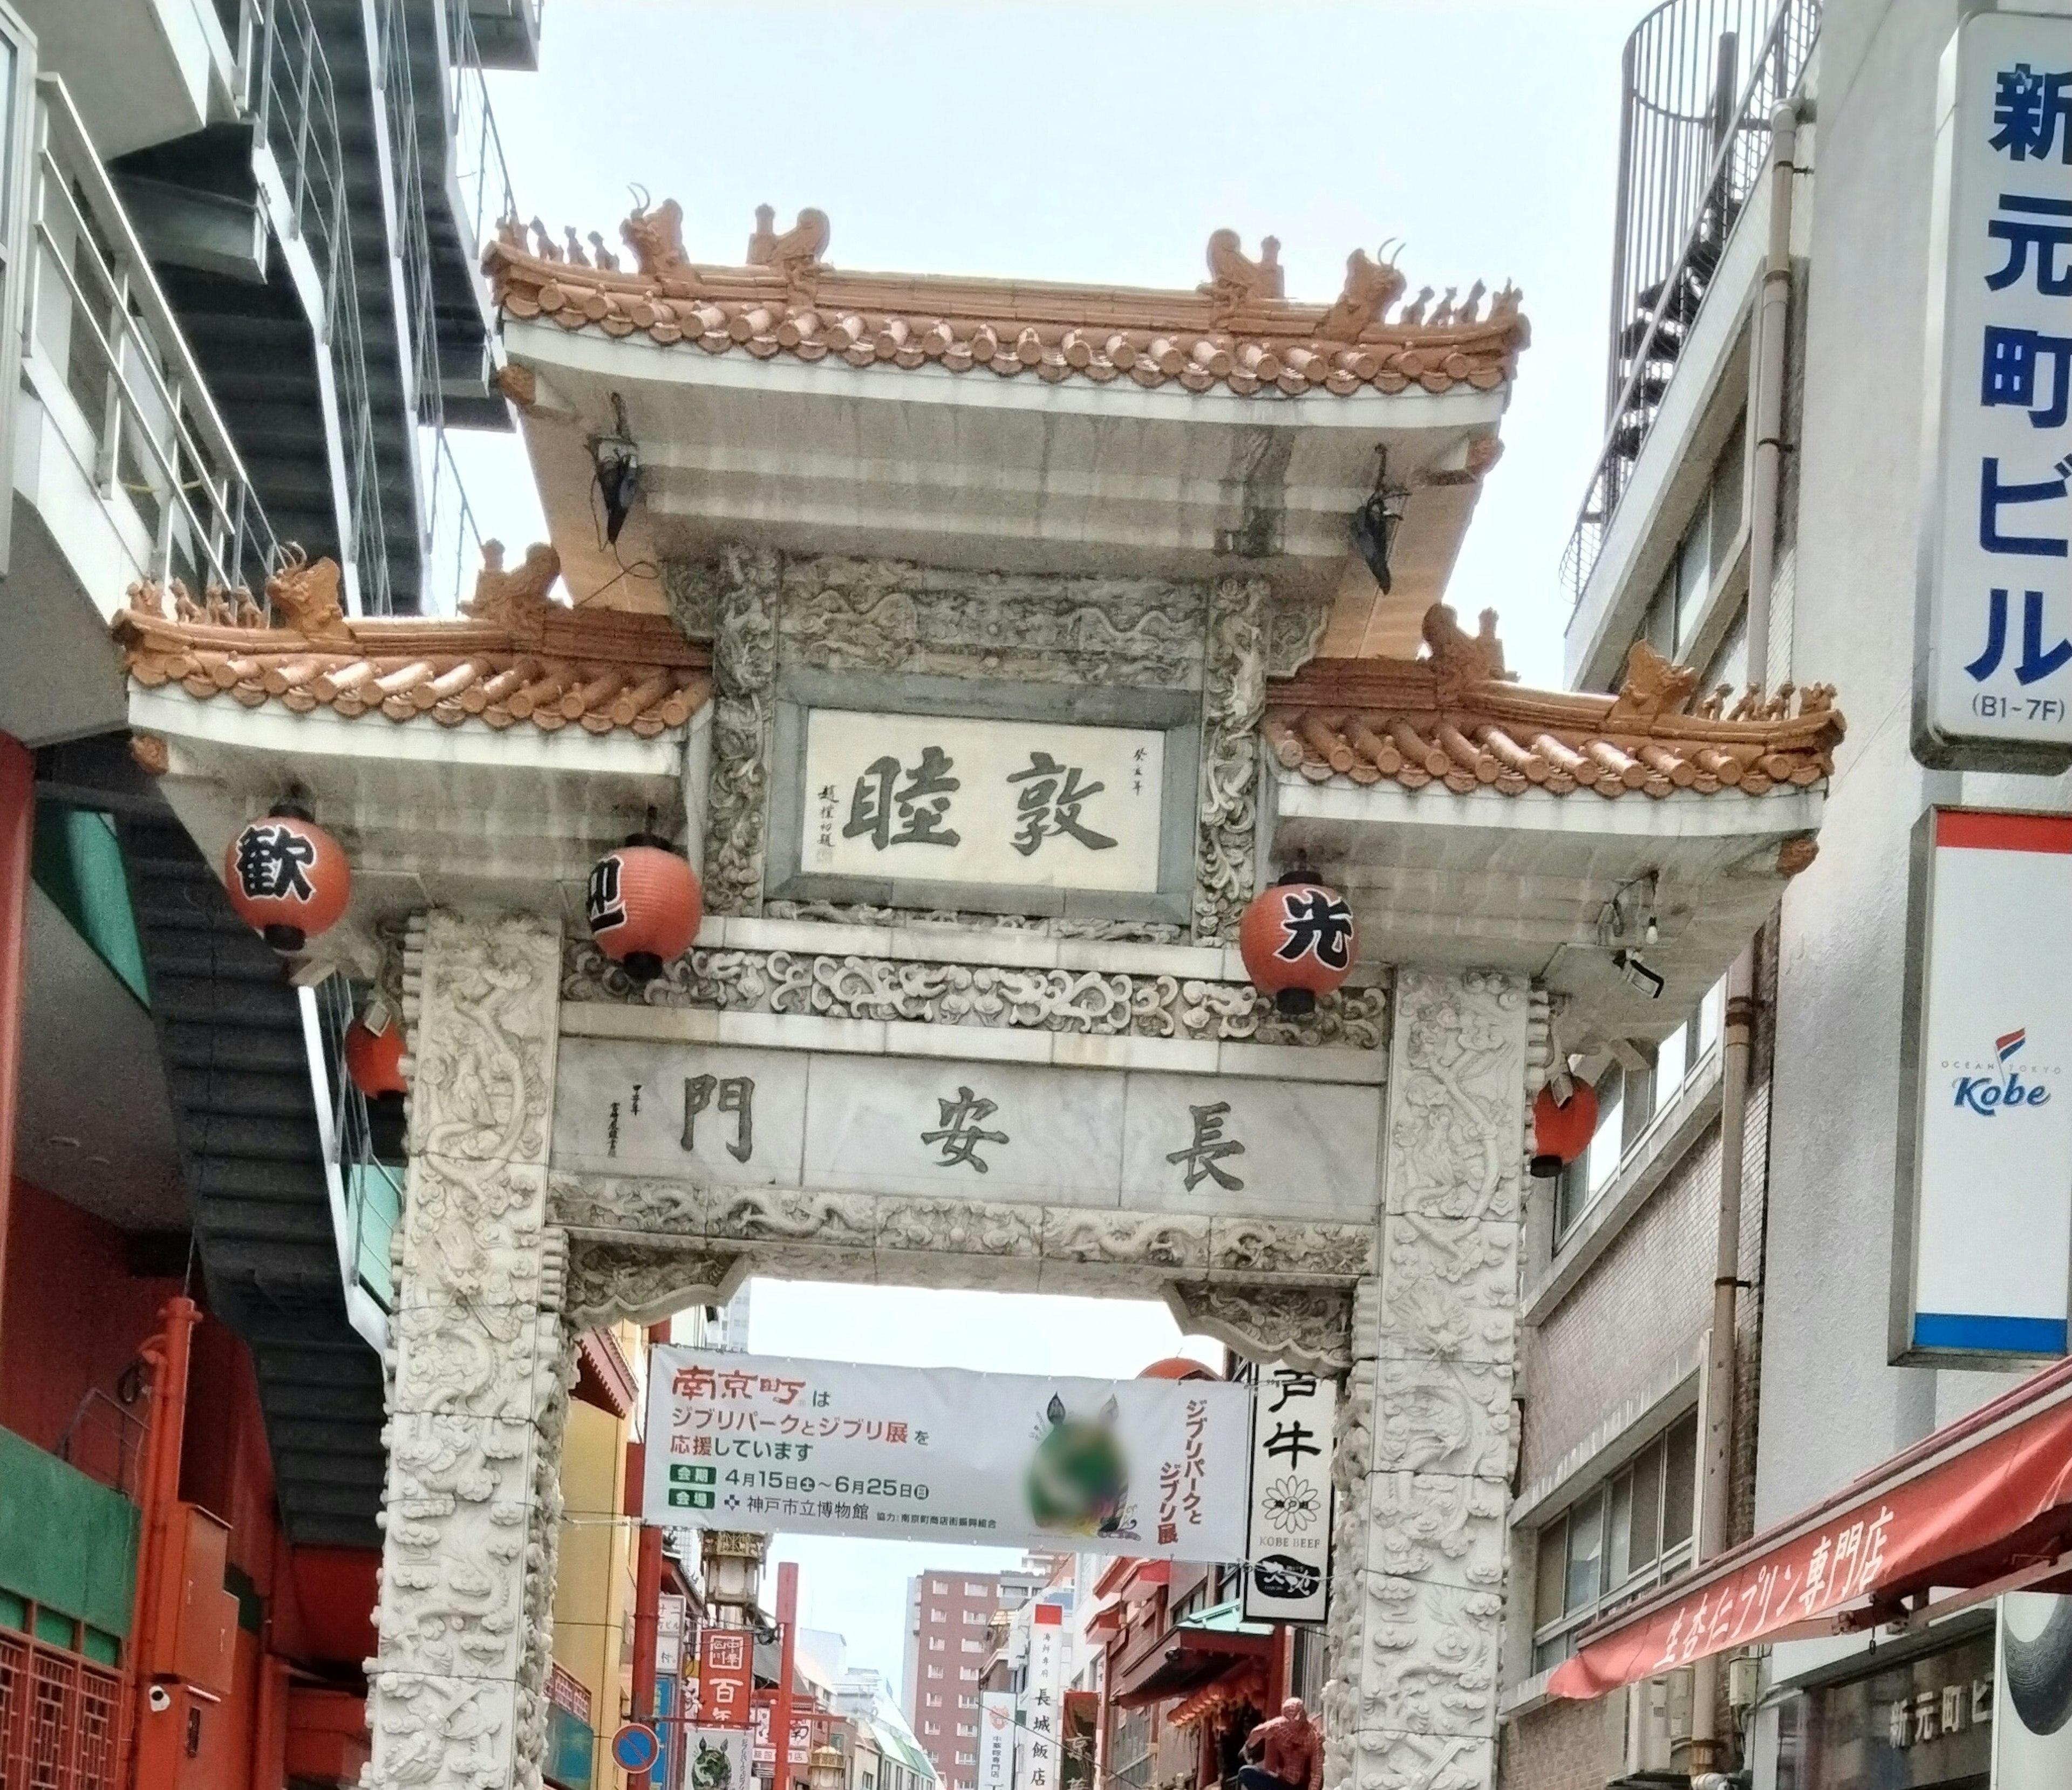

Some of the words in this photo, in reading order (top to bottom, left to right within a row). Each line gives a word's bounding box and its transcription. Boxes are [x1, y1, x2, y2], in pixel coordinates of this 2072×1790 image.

[1273, 888, 1354, 971] 光
[1952, 1073, 2051, 1117] Kobe
[670, 1435, 814, 1462] 応援しています
[1182, 1400, 1207, 1525] ジブリパークと
[747, 1495, 869, 1520] 神戸市立博物館
[1157, 1462, 1181, 1545] ジブリ展
[1259, 1536, 1289, 1547] KOBE
[1293, 1538, 1321, 1548] BEEF
[1653, 1505, 1894, 1669] 生杏仁プリン専門店
[1030, 1688, 1051, 1786] 長城飯店
